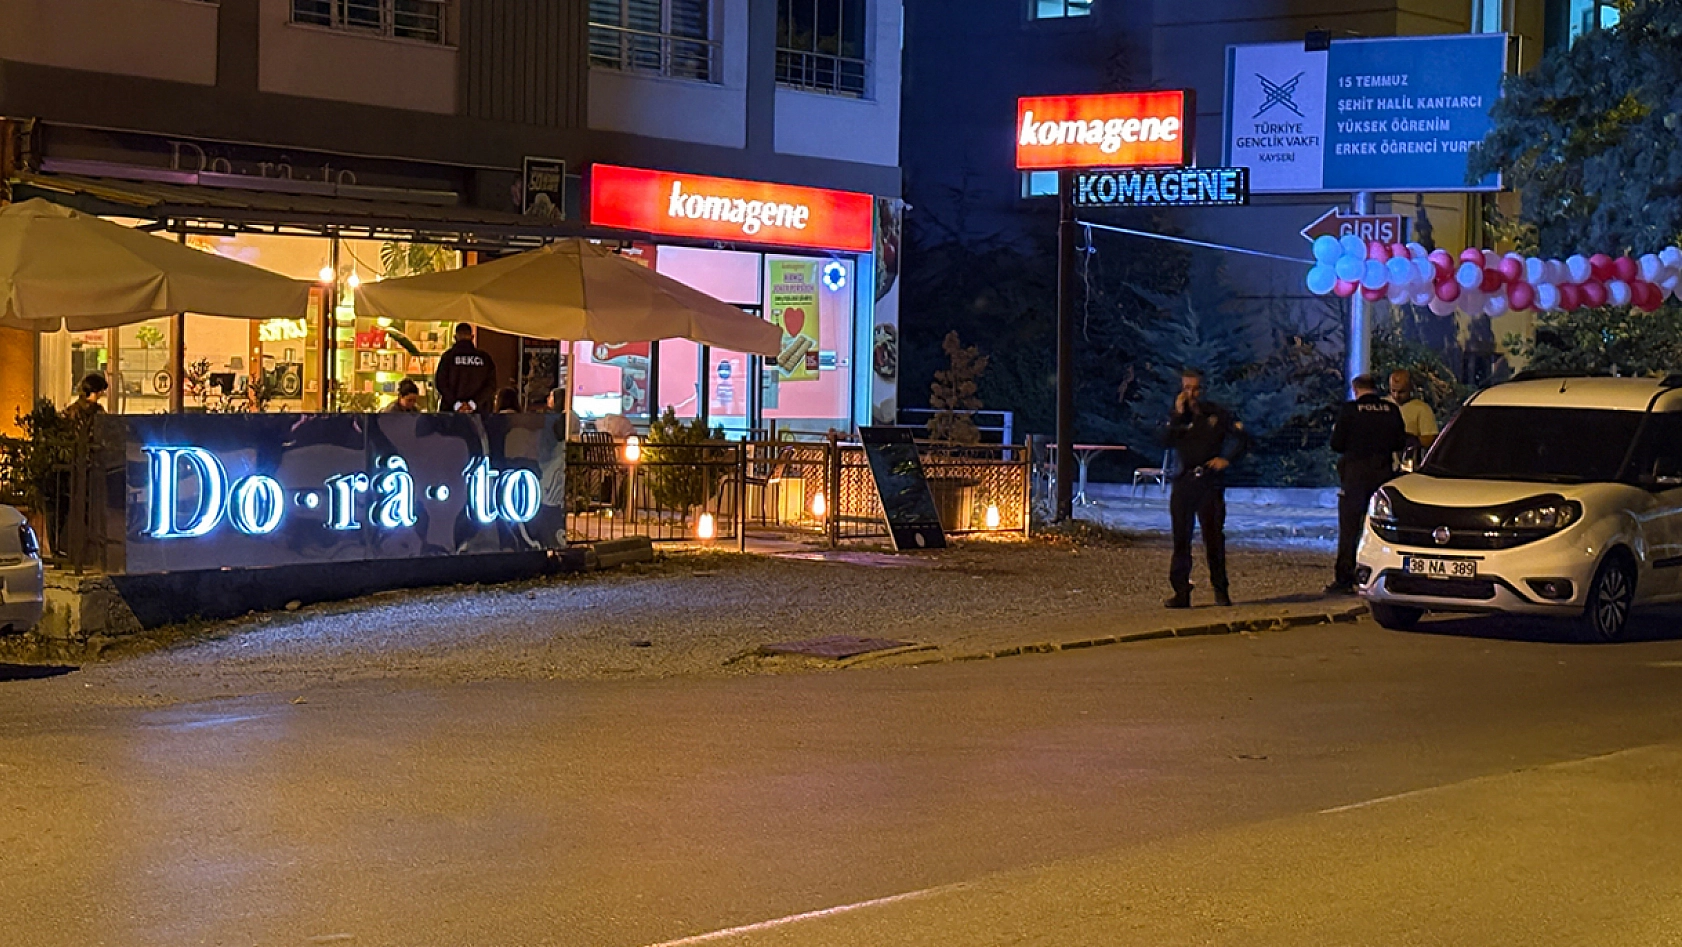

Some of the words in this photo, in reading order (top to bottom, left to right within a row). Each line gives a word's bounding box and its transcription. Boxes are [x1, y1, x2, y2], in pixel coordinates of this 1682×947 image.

[1338, 76, 1352, 88] 15
[1356, 74, 1408, 88] TEMMUZ
[1338, 96, 1374, 114] ŞEHİT
[1377, 94, 1414, 110] HALİL
[1417, 95, 1482, 109] KANTARCI
[1018, 110, 1180, 154] komagene
[1254, 121, 1303, 135] TÜRKİYE
[1337, 118, 1388, 133] YÜKSEK
[1391, 116, 1450, 132] ÖĞRENİM
[1286, 136, 1319, 147] VAKFI
[1335, 141, 1377, 155] ERKEK
[1380, 138, 1437, 154] ÖĞRENCİ
[1259, 152, 1295, 162] KAYSERİ
[1079, 172, 1237, 203] KOMAGENE
[668, 180, 809, 234] komagene
[1411, 558, 1425, 572] 38
[1428, 560, 1447, 574] NA
